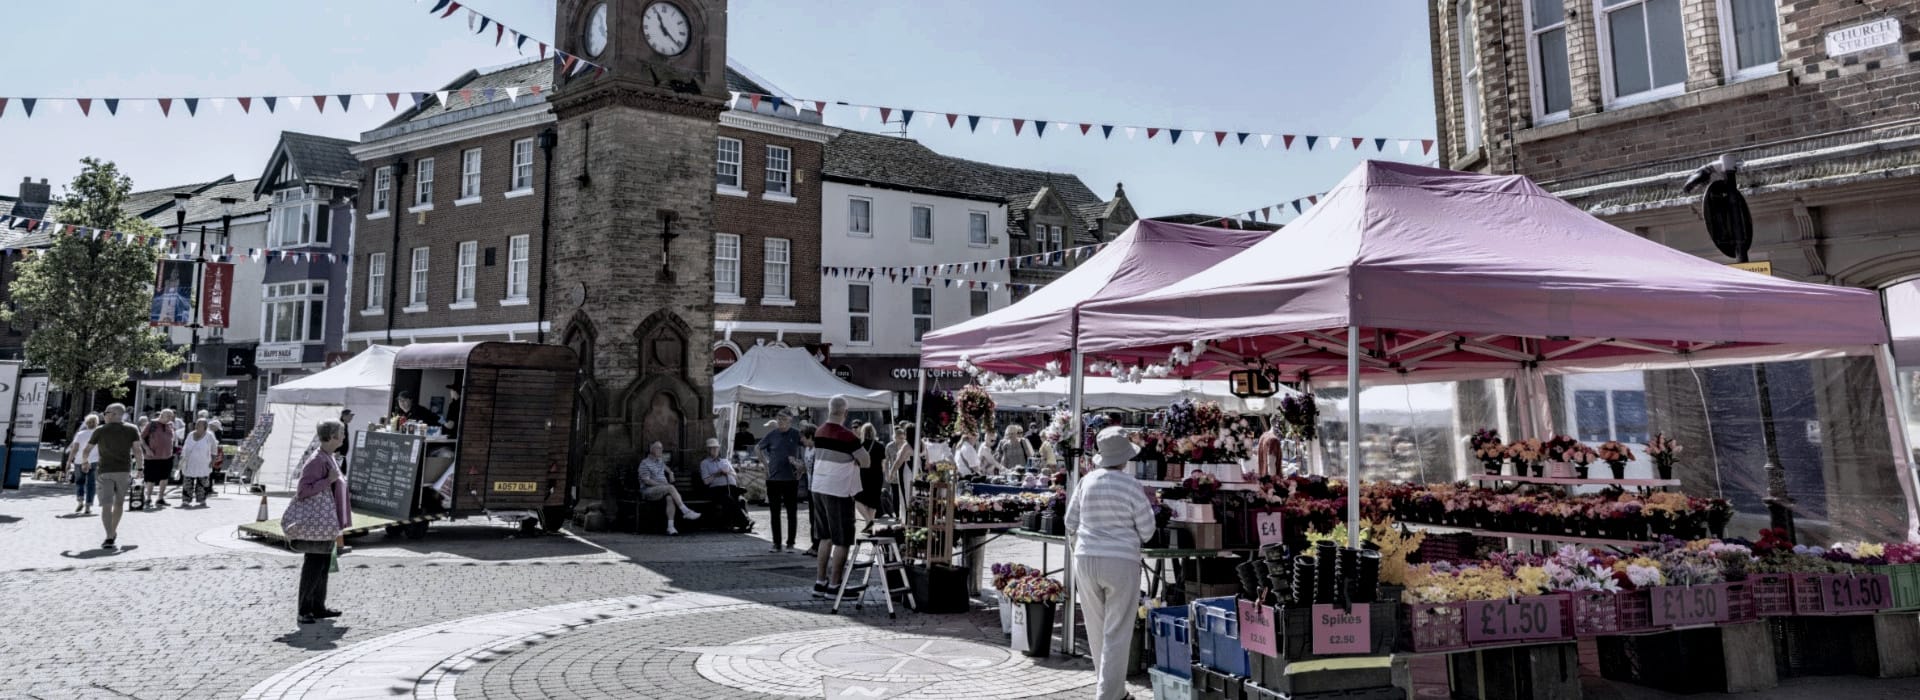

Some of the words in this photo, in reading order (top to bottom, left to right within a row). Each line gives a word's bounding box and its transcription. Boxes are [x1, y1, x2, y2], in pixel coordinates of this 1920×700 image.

[1832, 20, 1891, 42] CHURCH
[1838, 32, 1888, 52] STREET
[927, 368, 963, 378] COFFEE
[18, 381, 44, 403] SALE
[1260, 522, 1277, 536] £4
[1832, 577, 1882, 607] £1.50
[1663, 587, 1717, 620] £1.50
[1014, 610, 1024, 625] £2
[1244, 610, 1270, 628] Spikes
[1321, 614, 1362, 627] Spikes
[1481, 602, 1548, 635] £1.50
[1329, 635, 1355, 645] £2.50
